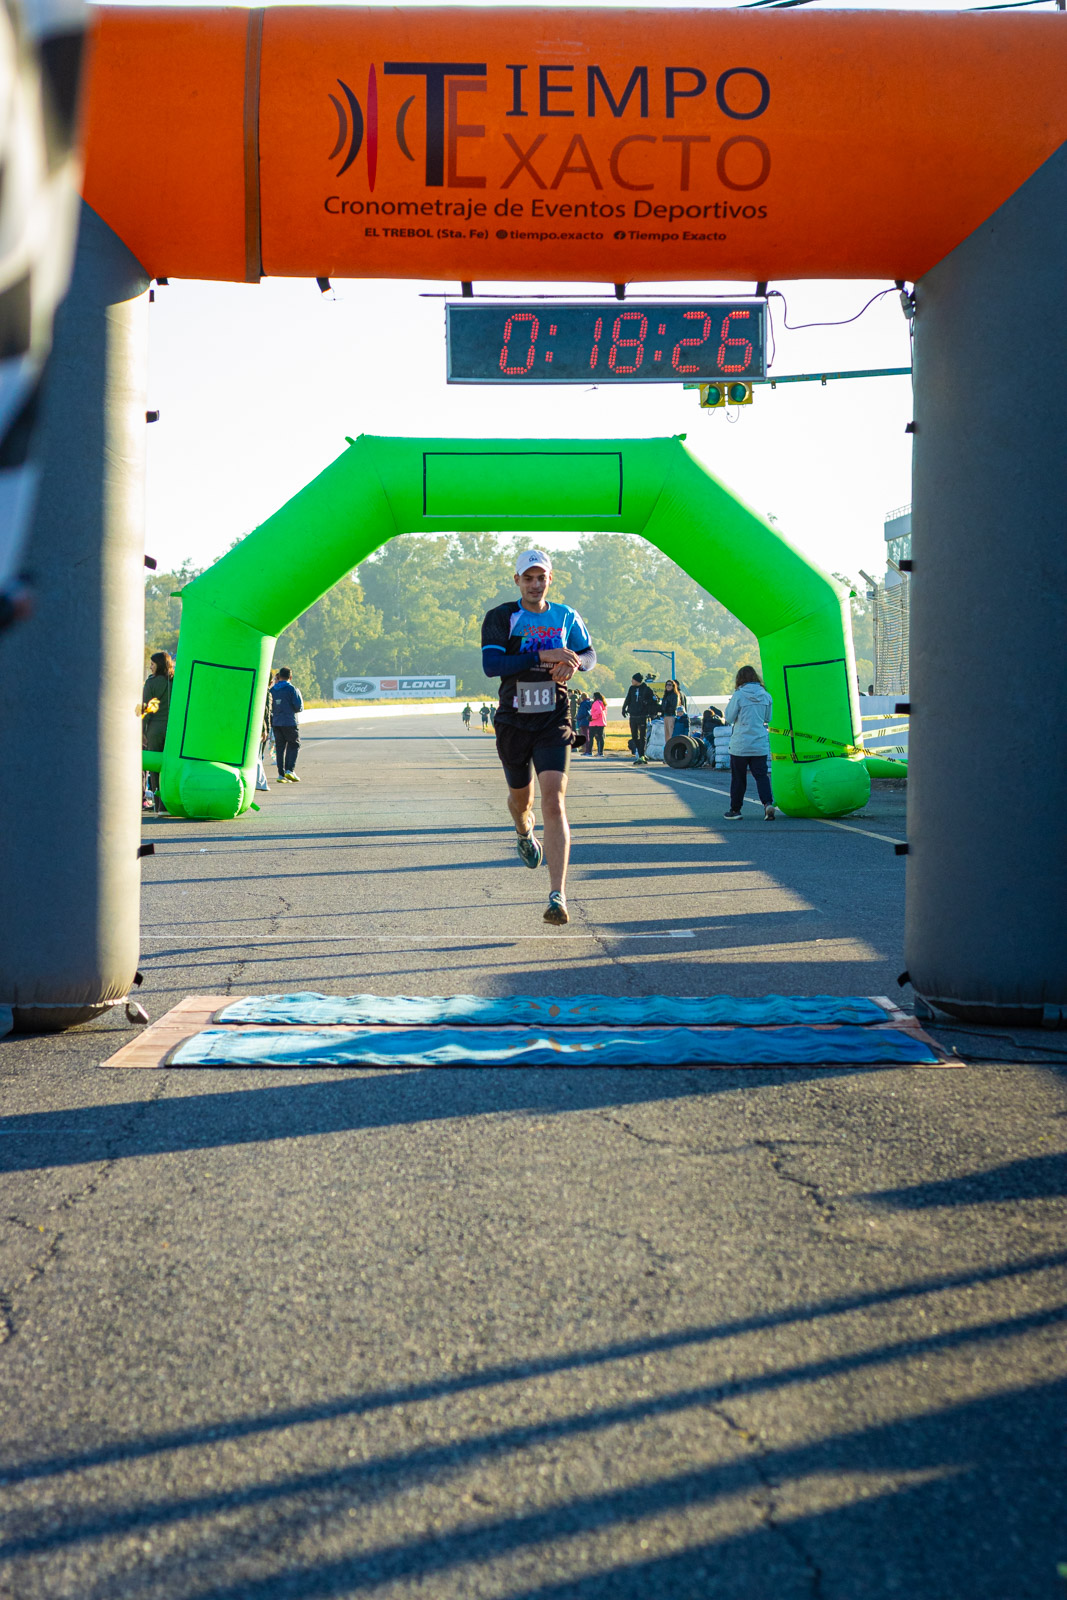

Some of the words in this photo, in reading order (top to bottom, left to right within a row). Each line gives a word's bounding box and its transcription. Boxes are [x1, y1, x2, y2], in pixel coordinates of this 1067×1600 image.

[447, 80, 772, 192] EXACTO
[324, 195, 487, 221] Cronometraje
[494, 198, 524, 217] de
[531, 199, 626, 218] Eventos
[634, 200, 768, 222] Deportivos
[364, 227, 380, 238] EL
[382, 228, 434, 239] TREBOL
[437, 229, 466, 240] (Sta.
[469, 229, 489, 239] Fe)
[510, 230, 604, 241] tiempo.exacto
[628, 231, 679, 243] Tiempo
[682, 231, 727, 241] Exacto
[343, 682, 368, 693] Ford
[401, 681, 447, 689] LONG
[524, 688, 550, 706] 118
